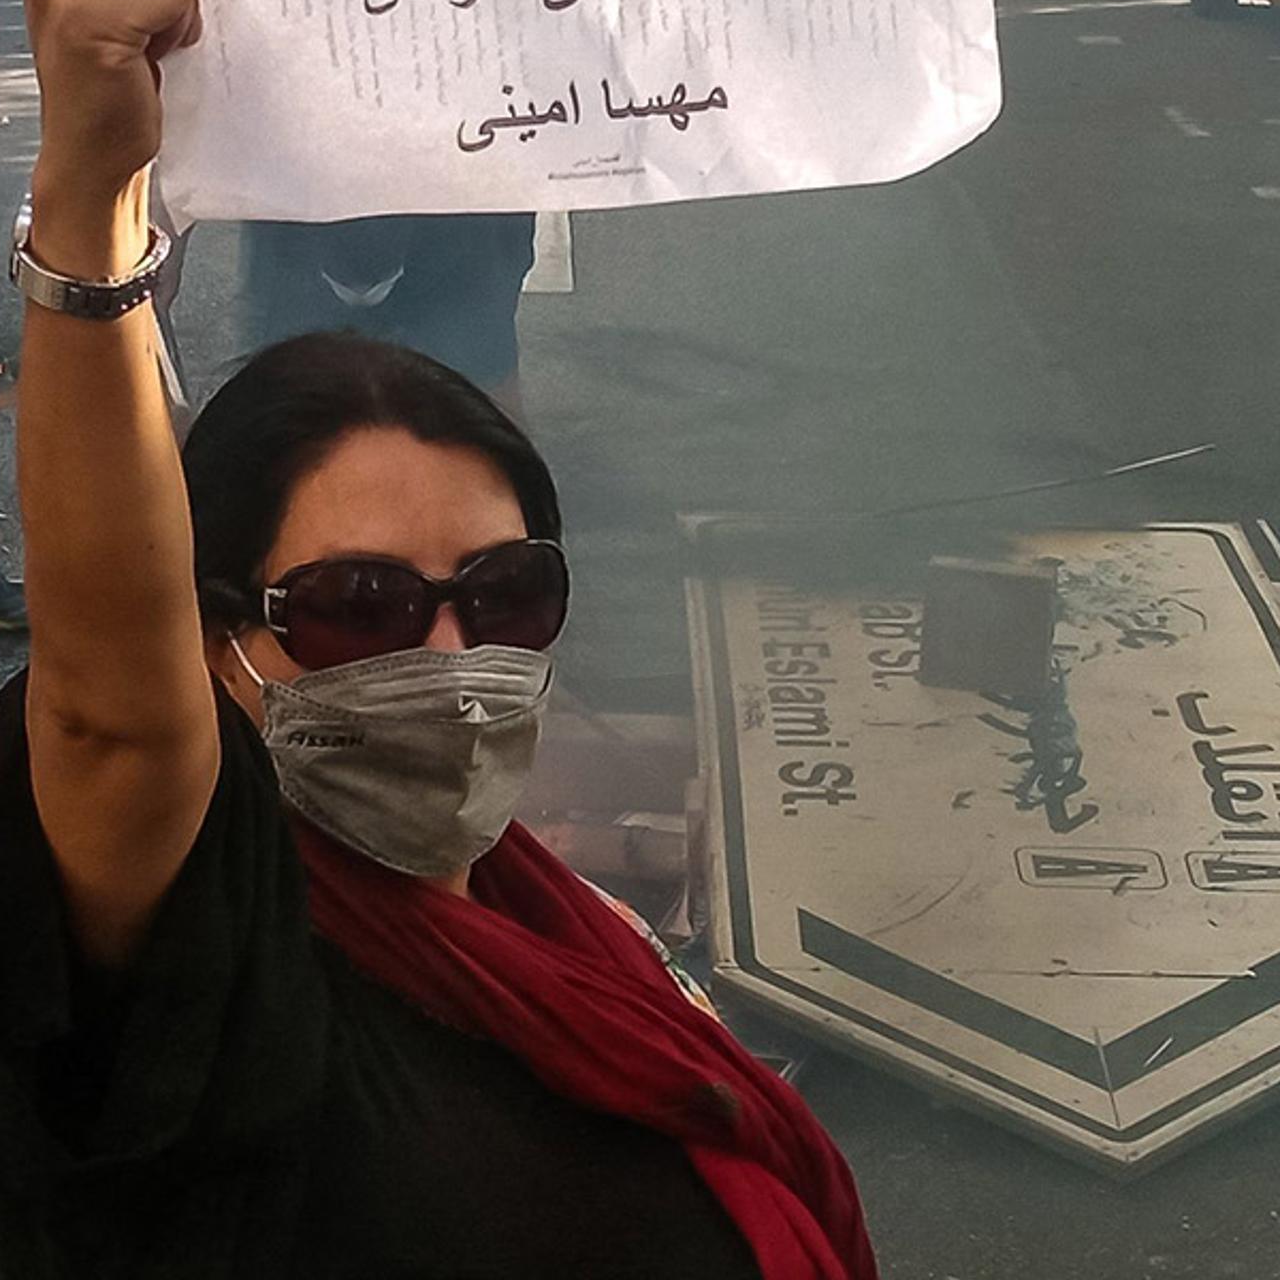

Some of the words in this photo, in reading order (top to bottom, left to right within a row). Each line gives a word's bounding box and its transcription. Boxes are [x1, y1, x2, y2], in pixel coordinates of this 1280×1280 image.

[457, 80, 581, 152] امینی
[601, 78, 728, 132] مهسا
[762, 641, 850, 749] Eslami
[778, 760, 857, 817] St.
